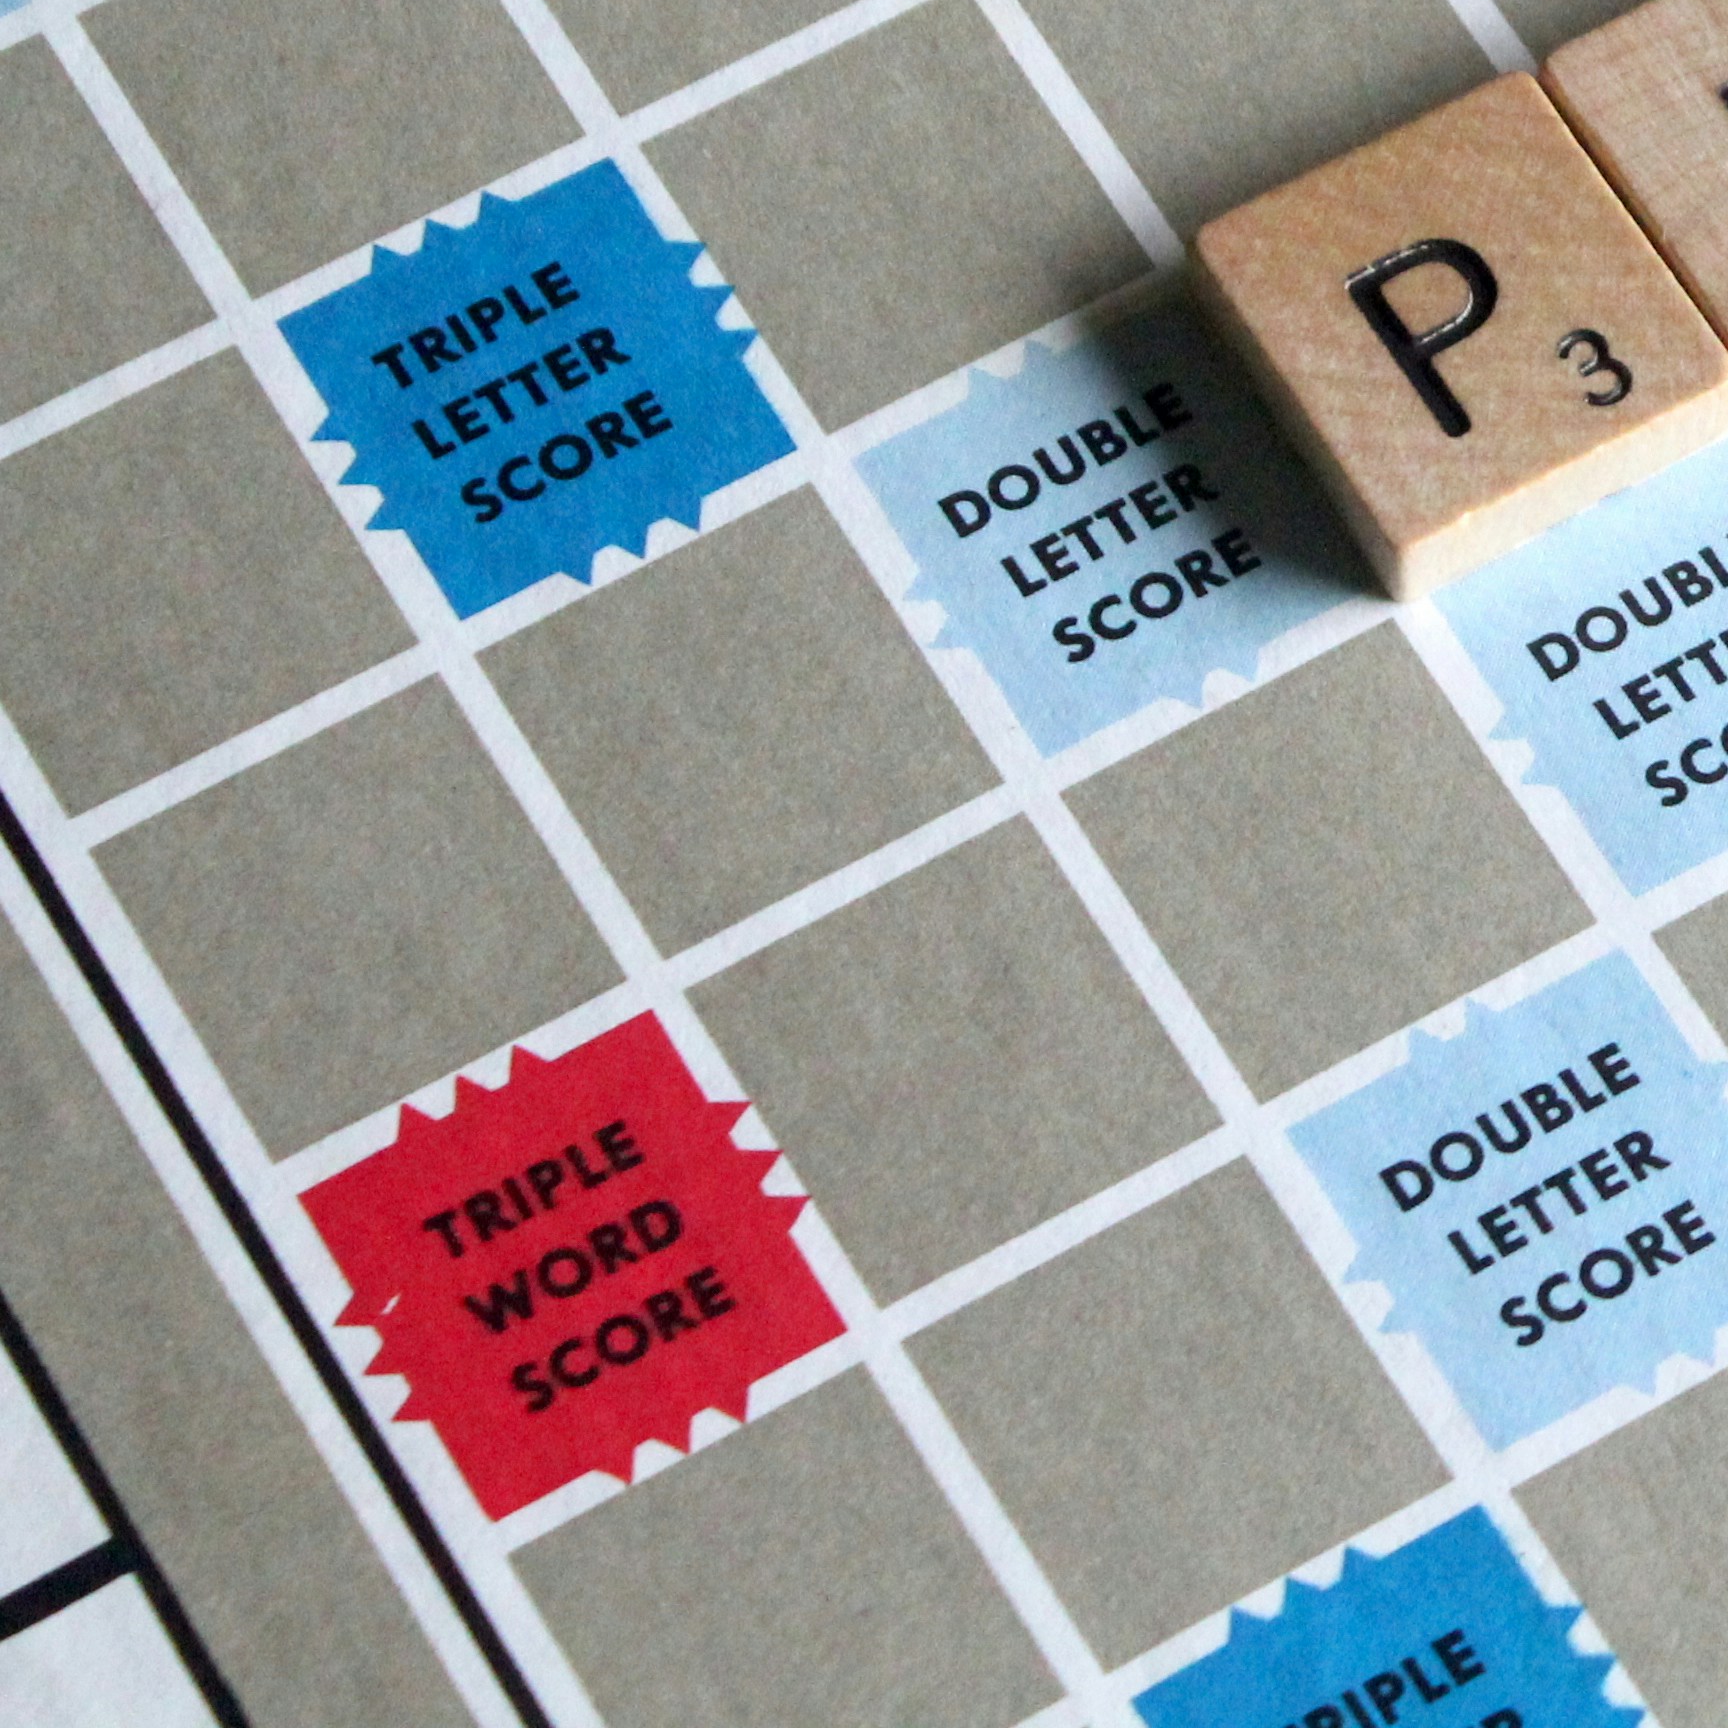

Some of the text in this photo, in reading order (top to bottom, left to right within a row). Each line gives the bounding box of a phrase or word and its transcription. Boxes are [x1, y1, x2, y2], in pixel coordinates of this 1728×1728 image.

[370, 261, 581, 390] TRIPLE
[411, 327, 632, 461] LETTER
[1347, 237, 1634, 439] P 3
[460, 389, 674, 525] SCORE
[936, 380, 1195, 540] DOUBLE
[999, 462, 1222, 599] LETTER
[1051, 526, 1263, 664] SCORE
[422, 1119, 645, 1259] TRIPLE
[1378, 1042, 1642, 1214] DOUBLE
[463, 1199, 684, 1335] WORD
[1446, 1130, 1672, 1276] LETTER
[510, 1265, 737, 1414] SCORE
[1498, 1199, 1717, 1348] SCORE
[1283, 1627, 1488, 1728] IPLE
